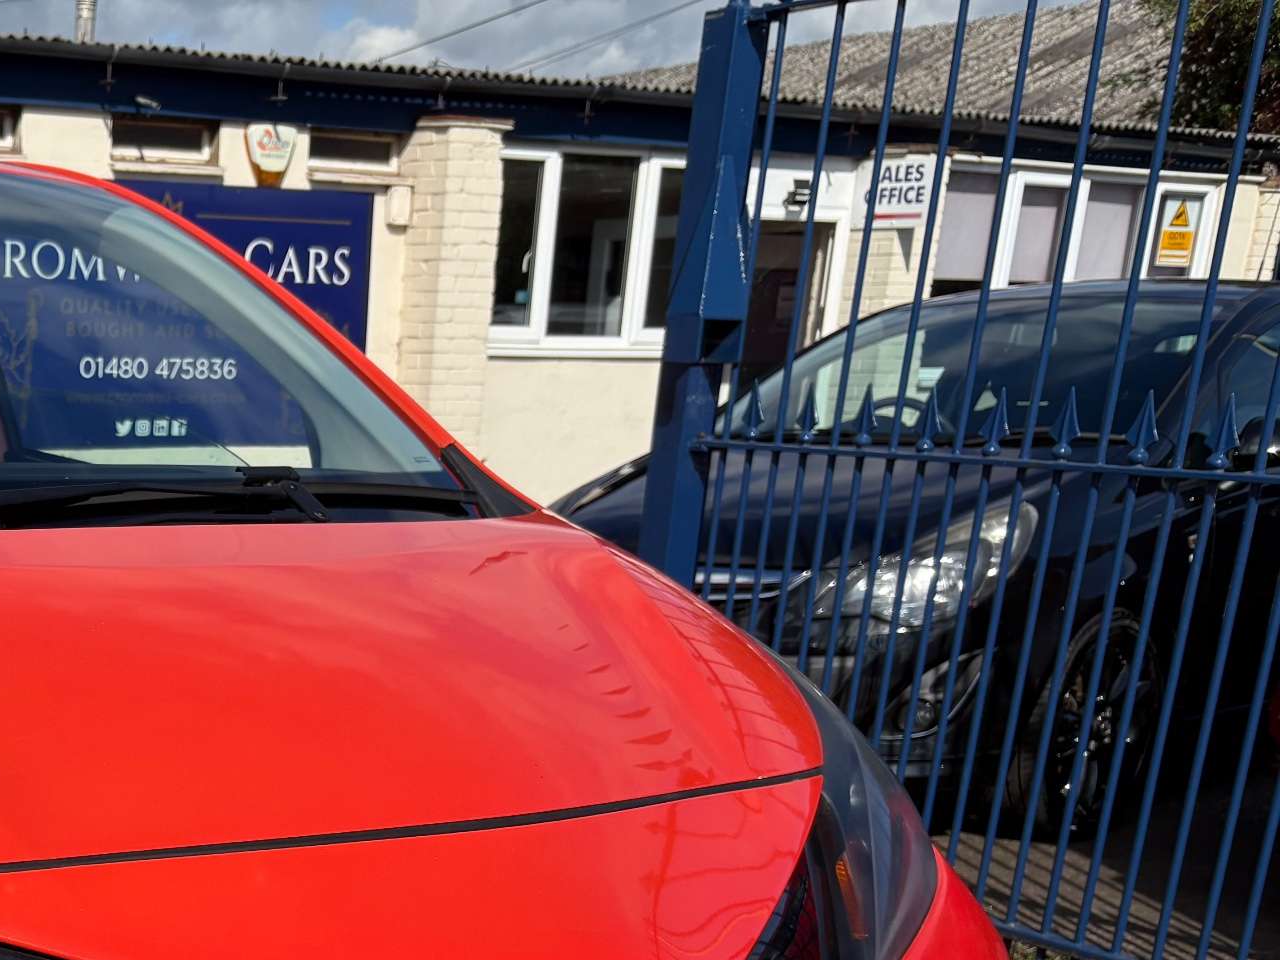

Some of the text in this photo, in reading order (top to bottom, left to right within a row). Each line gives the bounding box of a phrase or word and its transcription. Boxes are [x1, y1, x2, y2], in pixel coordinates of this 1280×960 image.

[880, 164, 925, 183] ALES
[243, 237, 352, 286] CARS
[79, 356, 237, 380] 01480 475836
